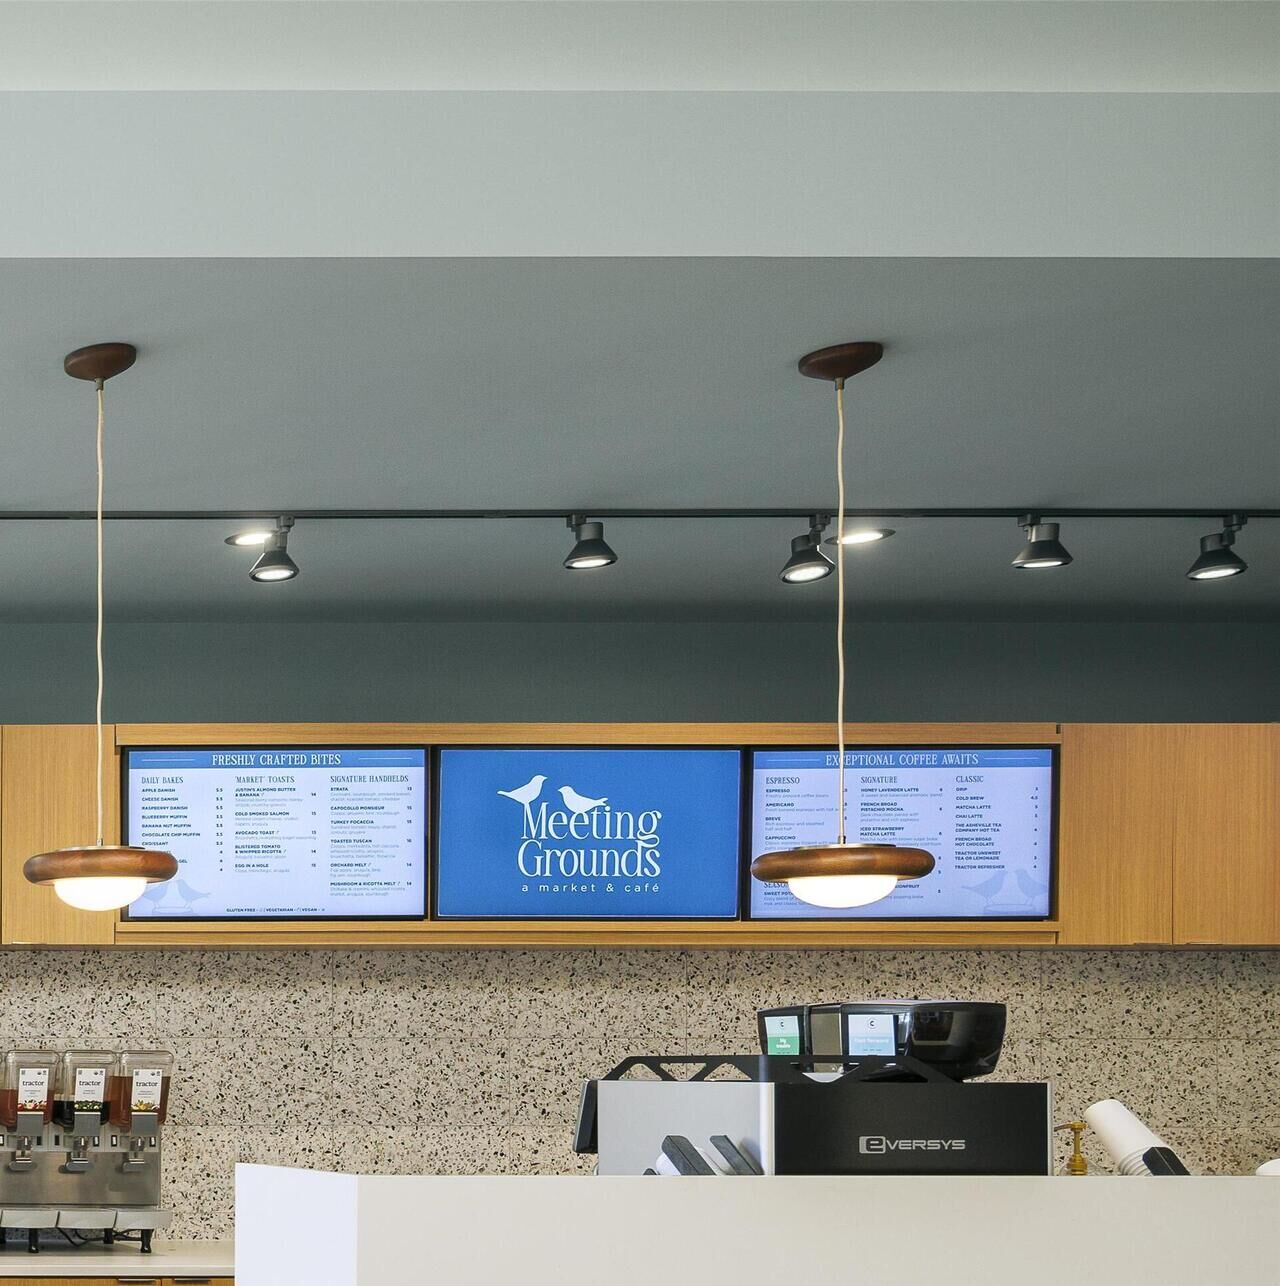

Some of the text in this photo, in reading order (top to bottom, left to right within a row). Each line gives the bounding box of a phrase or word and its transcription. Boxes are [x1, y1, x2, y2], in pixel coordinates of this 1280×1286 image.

[212, 754, 341, 765] FRESHLY CRAFTED BITES
[899, 754, 937, 765] COFFEE
[942, 754, 978, 764] AWAITS
[522, 802, 662, 848] Meeting
[518, 839, 661, 877] Grounds
[522, 883, 660, 892] a market & café
